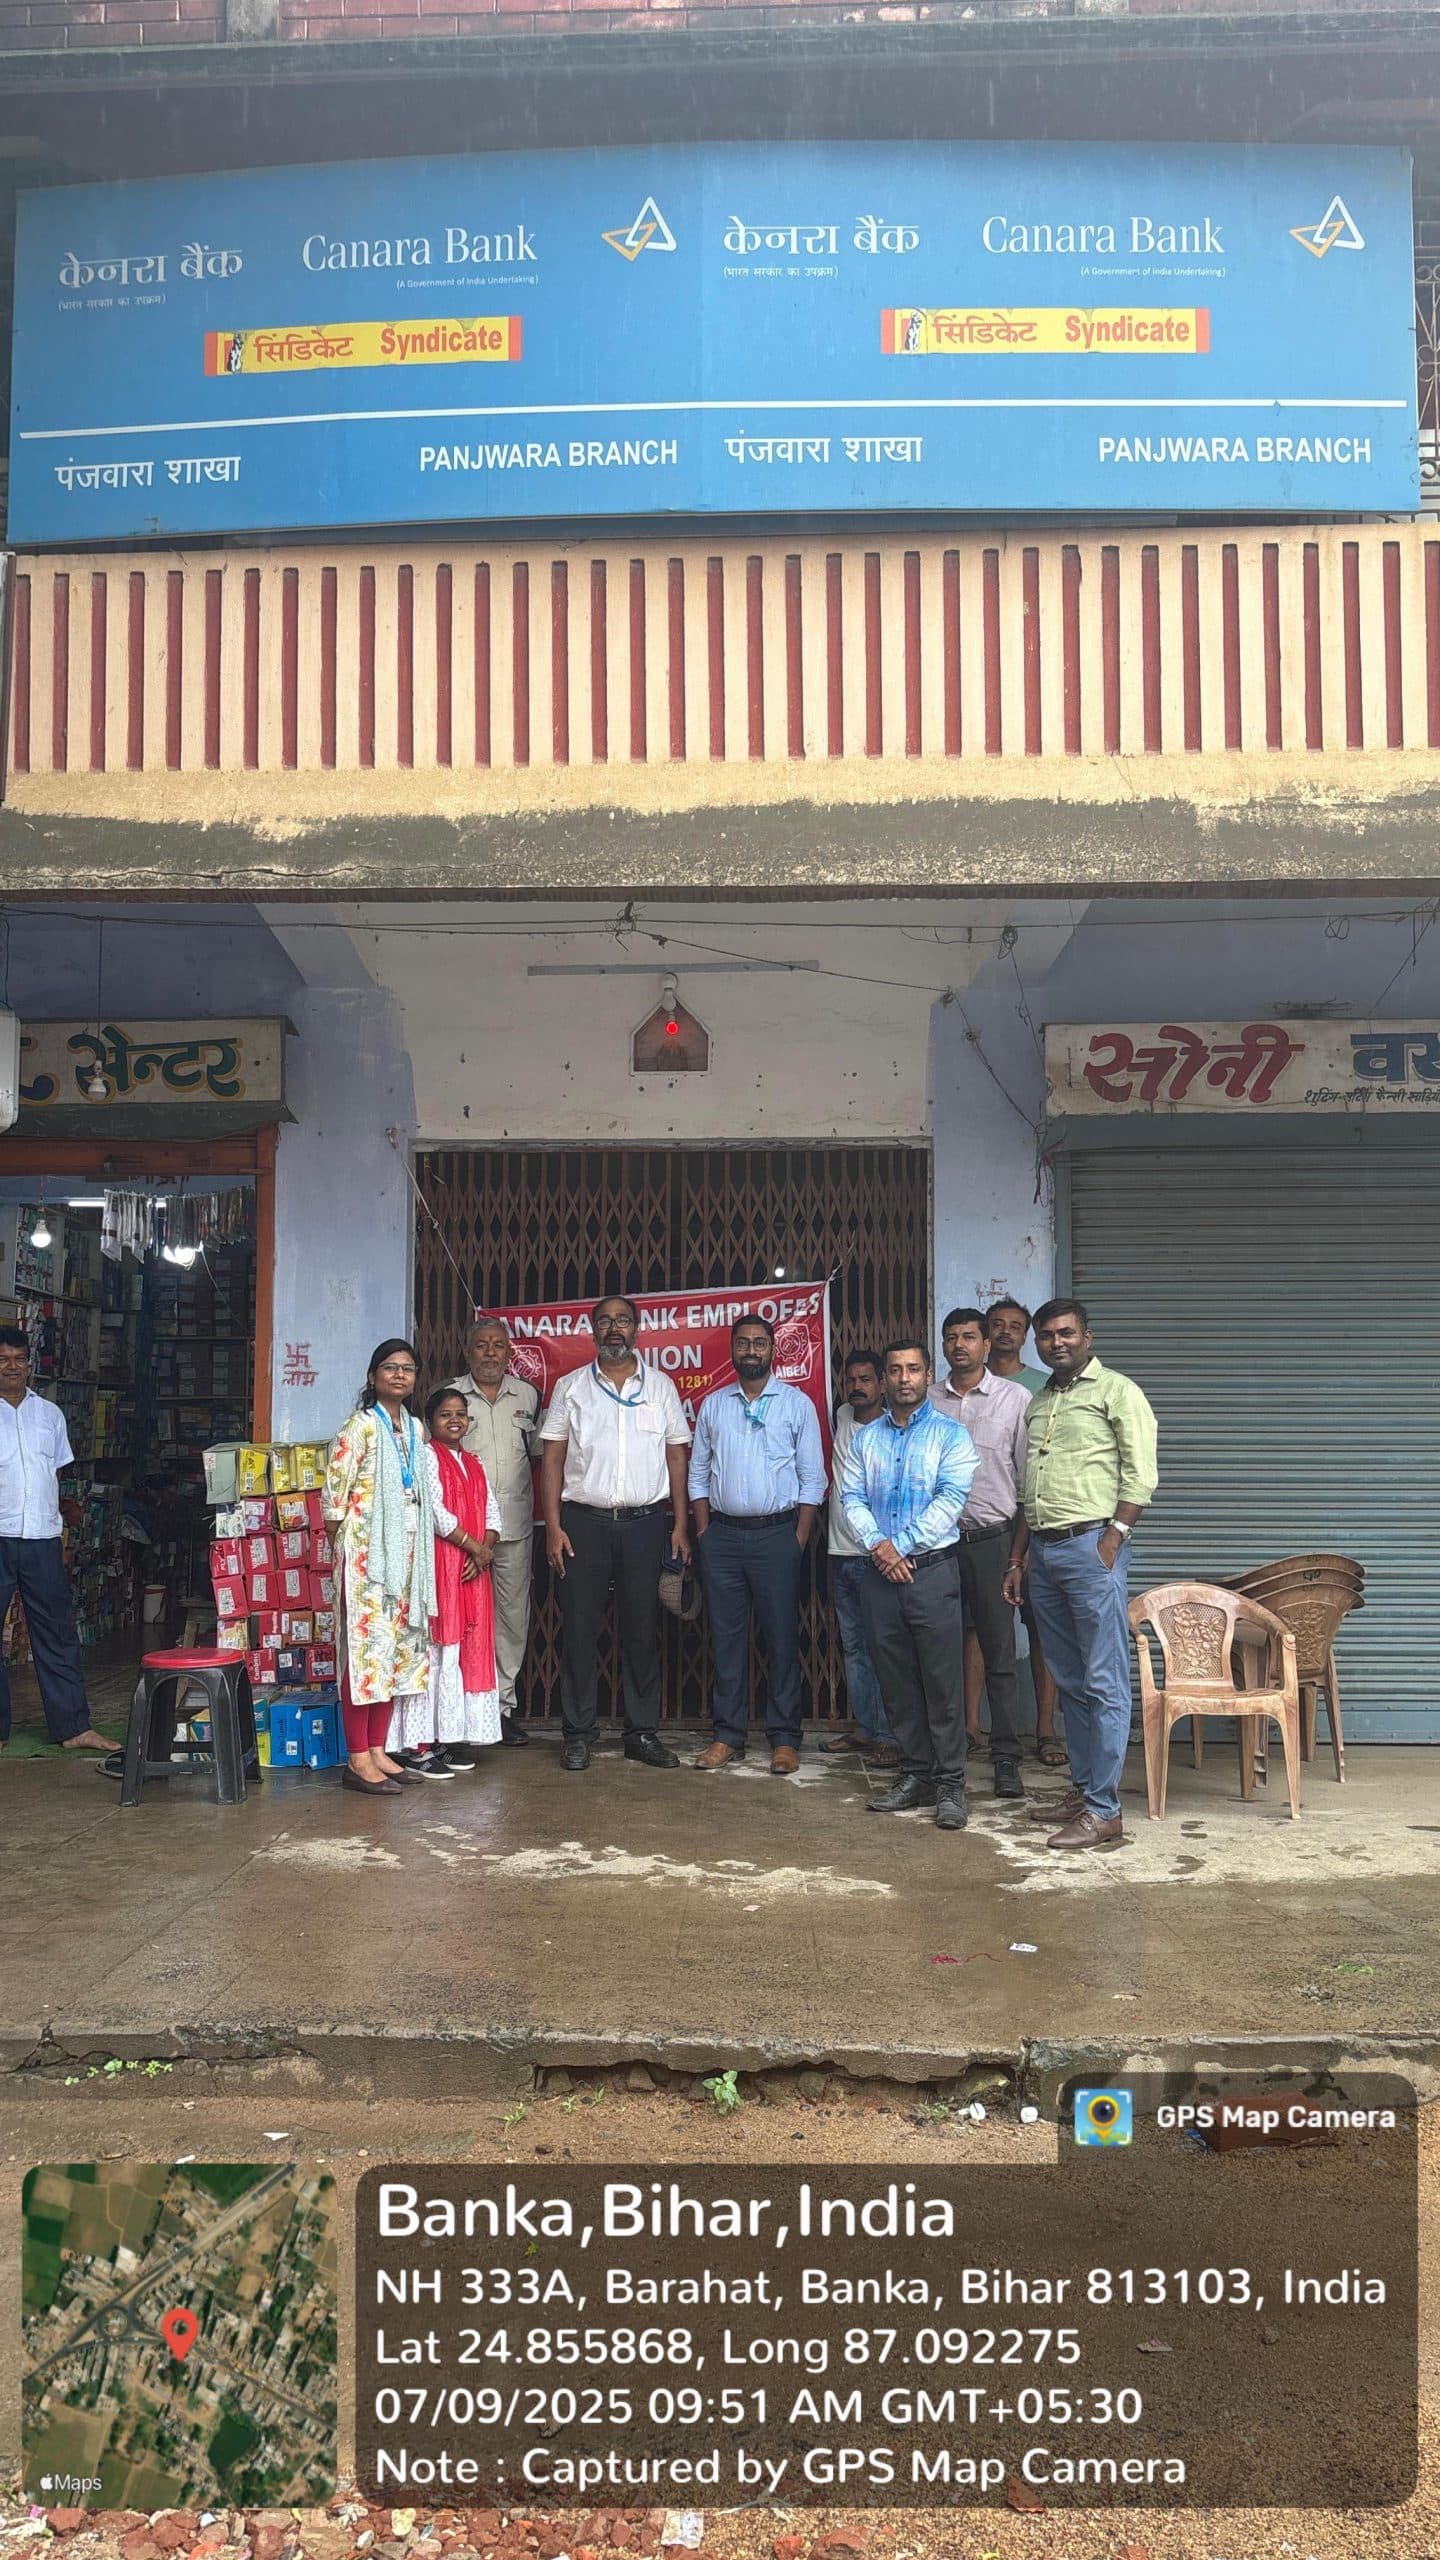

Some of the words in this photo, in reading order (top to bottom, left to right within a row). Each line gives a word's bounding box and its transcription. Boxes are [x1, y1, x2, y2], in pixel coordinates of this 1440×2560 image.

[302, 234, 432, 271] Canara
[445, 224, 539, 264] Bank
[723, 216, 840, 254] केनरा
[853, 215, 920, 254] बैंक
[982, 216, 1117, 254] Canara
[1130, 216, 1225, 253] Bank
[58, 252, 169, 288] केनरा
[180, 242, 243, 279] बैंक
[723, 265, 749, 279] (भारत
[753, 266, 783, 278] सरकार
[787, 266, 801, 278] का
[804, 265, 839, 279] उपक्रम)
[1092, 266, 1141, 277] Government
[1142, 266, 1151, 276] of
[1152, 266, 1172, 276] India
[1174, 266, 1226, 277] Undertaking)
[397, 279, 406, 290] (A
[407, 279, 456, 289] Government
[457, 277, 465, 287] of
[467, 276, 486, 286] India
[488, 274, 539, 285] Undertaking)
[118, 297, 130, 308] का
[380, 325, 503, 361] Syndicate
[932, 313, 1038, 344] सिंडिकेट
[1065, 315, 1191, 350] Syndicate
[254, 328, 354, 363] सिंडिकेट
[420, 443, 562, 472] PANJWARA
[569, 439, 678, 468] BRANCH
[724, 431, 831, 464] पंजवारा
[842, 436, 923, 464] शाखा
[1099, 437, 1250, 463] PANJWARA
[1256, 437, 1371, 463] BRANCH
[55, 456, 154, 491] पंजवारा
[166, 455, 241, 485] शाखा
[68, 1025, 240, 1098] सेन्टर
[1083, 1024, 1306, 1103] सोनी
[500, 1312, 594, 1340] ANARA
[632, 1344, 702, 1371] NION
[775, 1363, 808, 1380] AIBEA
